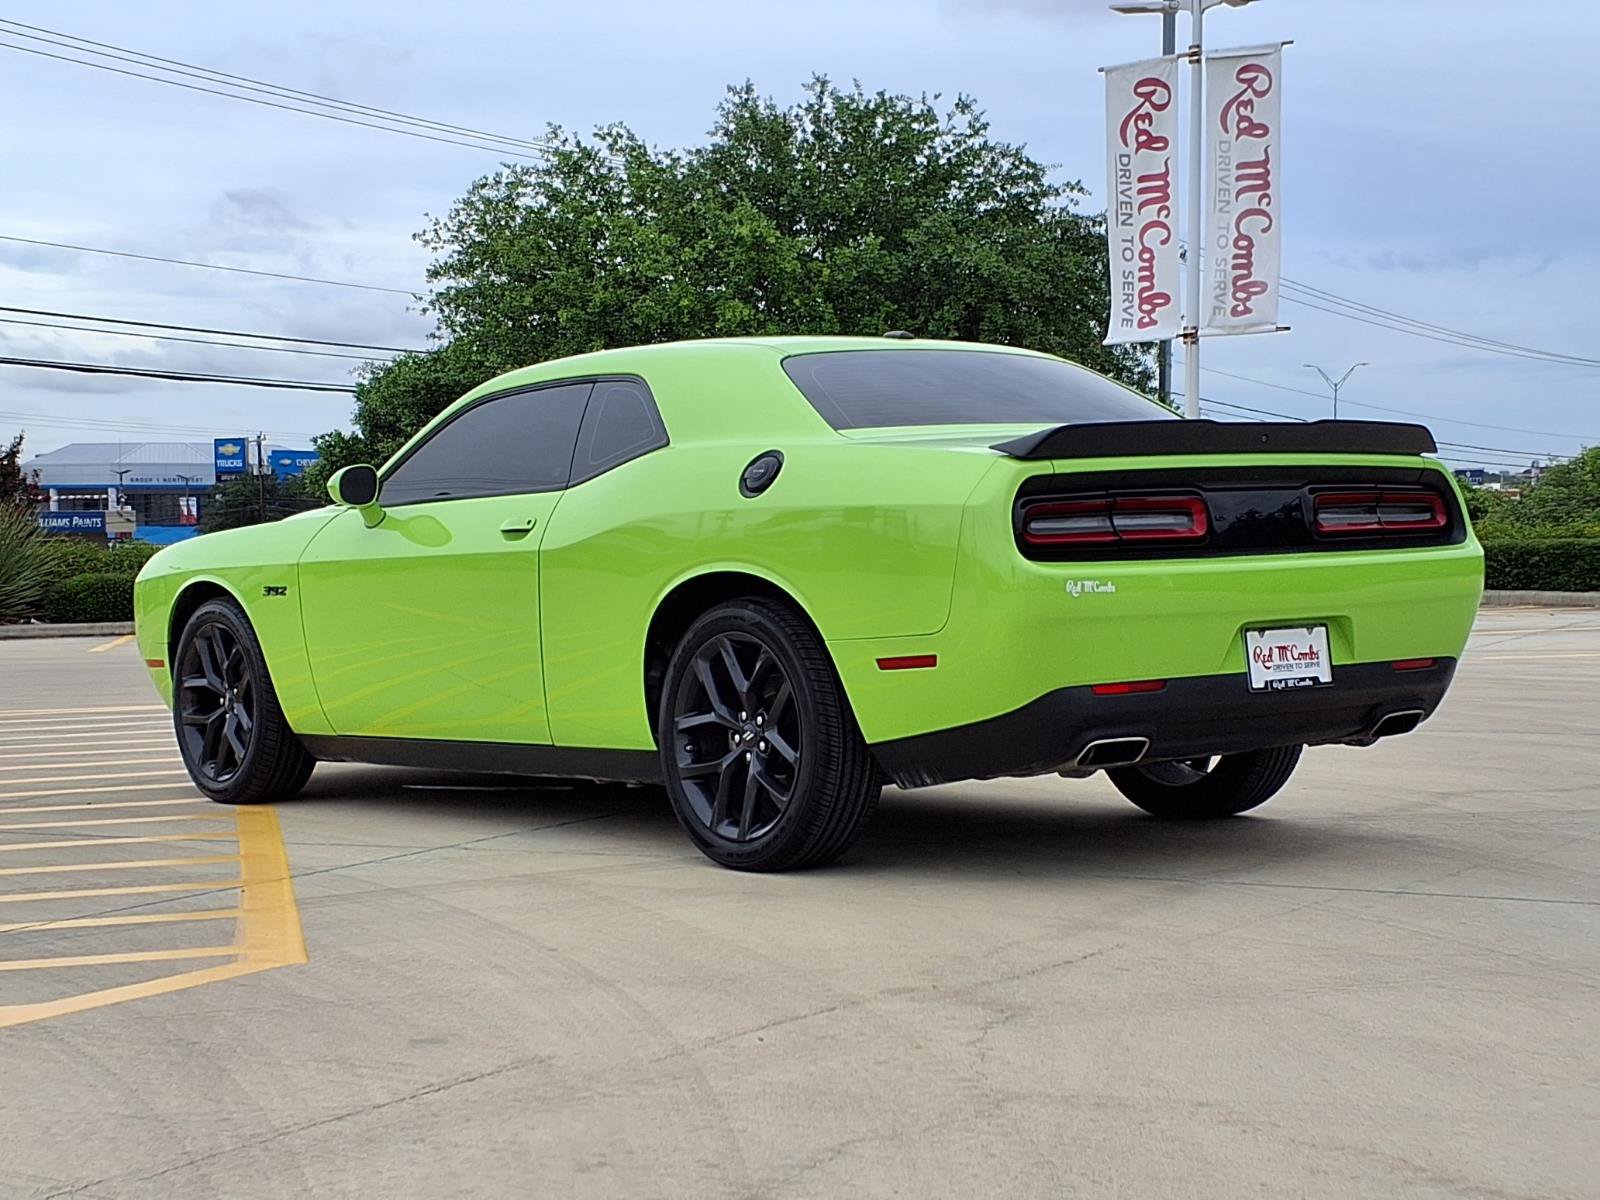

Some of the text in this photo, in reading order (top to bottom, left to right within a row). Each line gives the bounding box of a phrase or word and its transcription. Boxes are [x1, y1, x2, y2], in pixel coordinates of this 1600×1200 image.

[1220, 63, 1273, 141] Red
[1119, 77, 1172, 155] Red
[1212, 140, 1231, 318] DRIVEN TO SERVE
[1118, 153, 1135, 329] DRIVEN TO SERVE
[216, 459, 243, 468] TRUCKS
[72, 516, 102, 528] PAINTS
[262, 586, 287, 597] 392
[1065, 579, 1081, 597] Red
[1253, 645, 1274, 670] Red
[1273, 663, 1294, 671] DRIVEN
